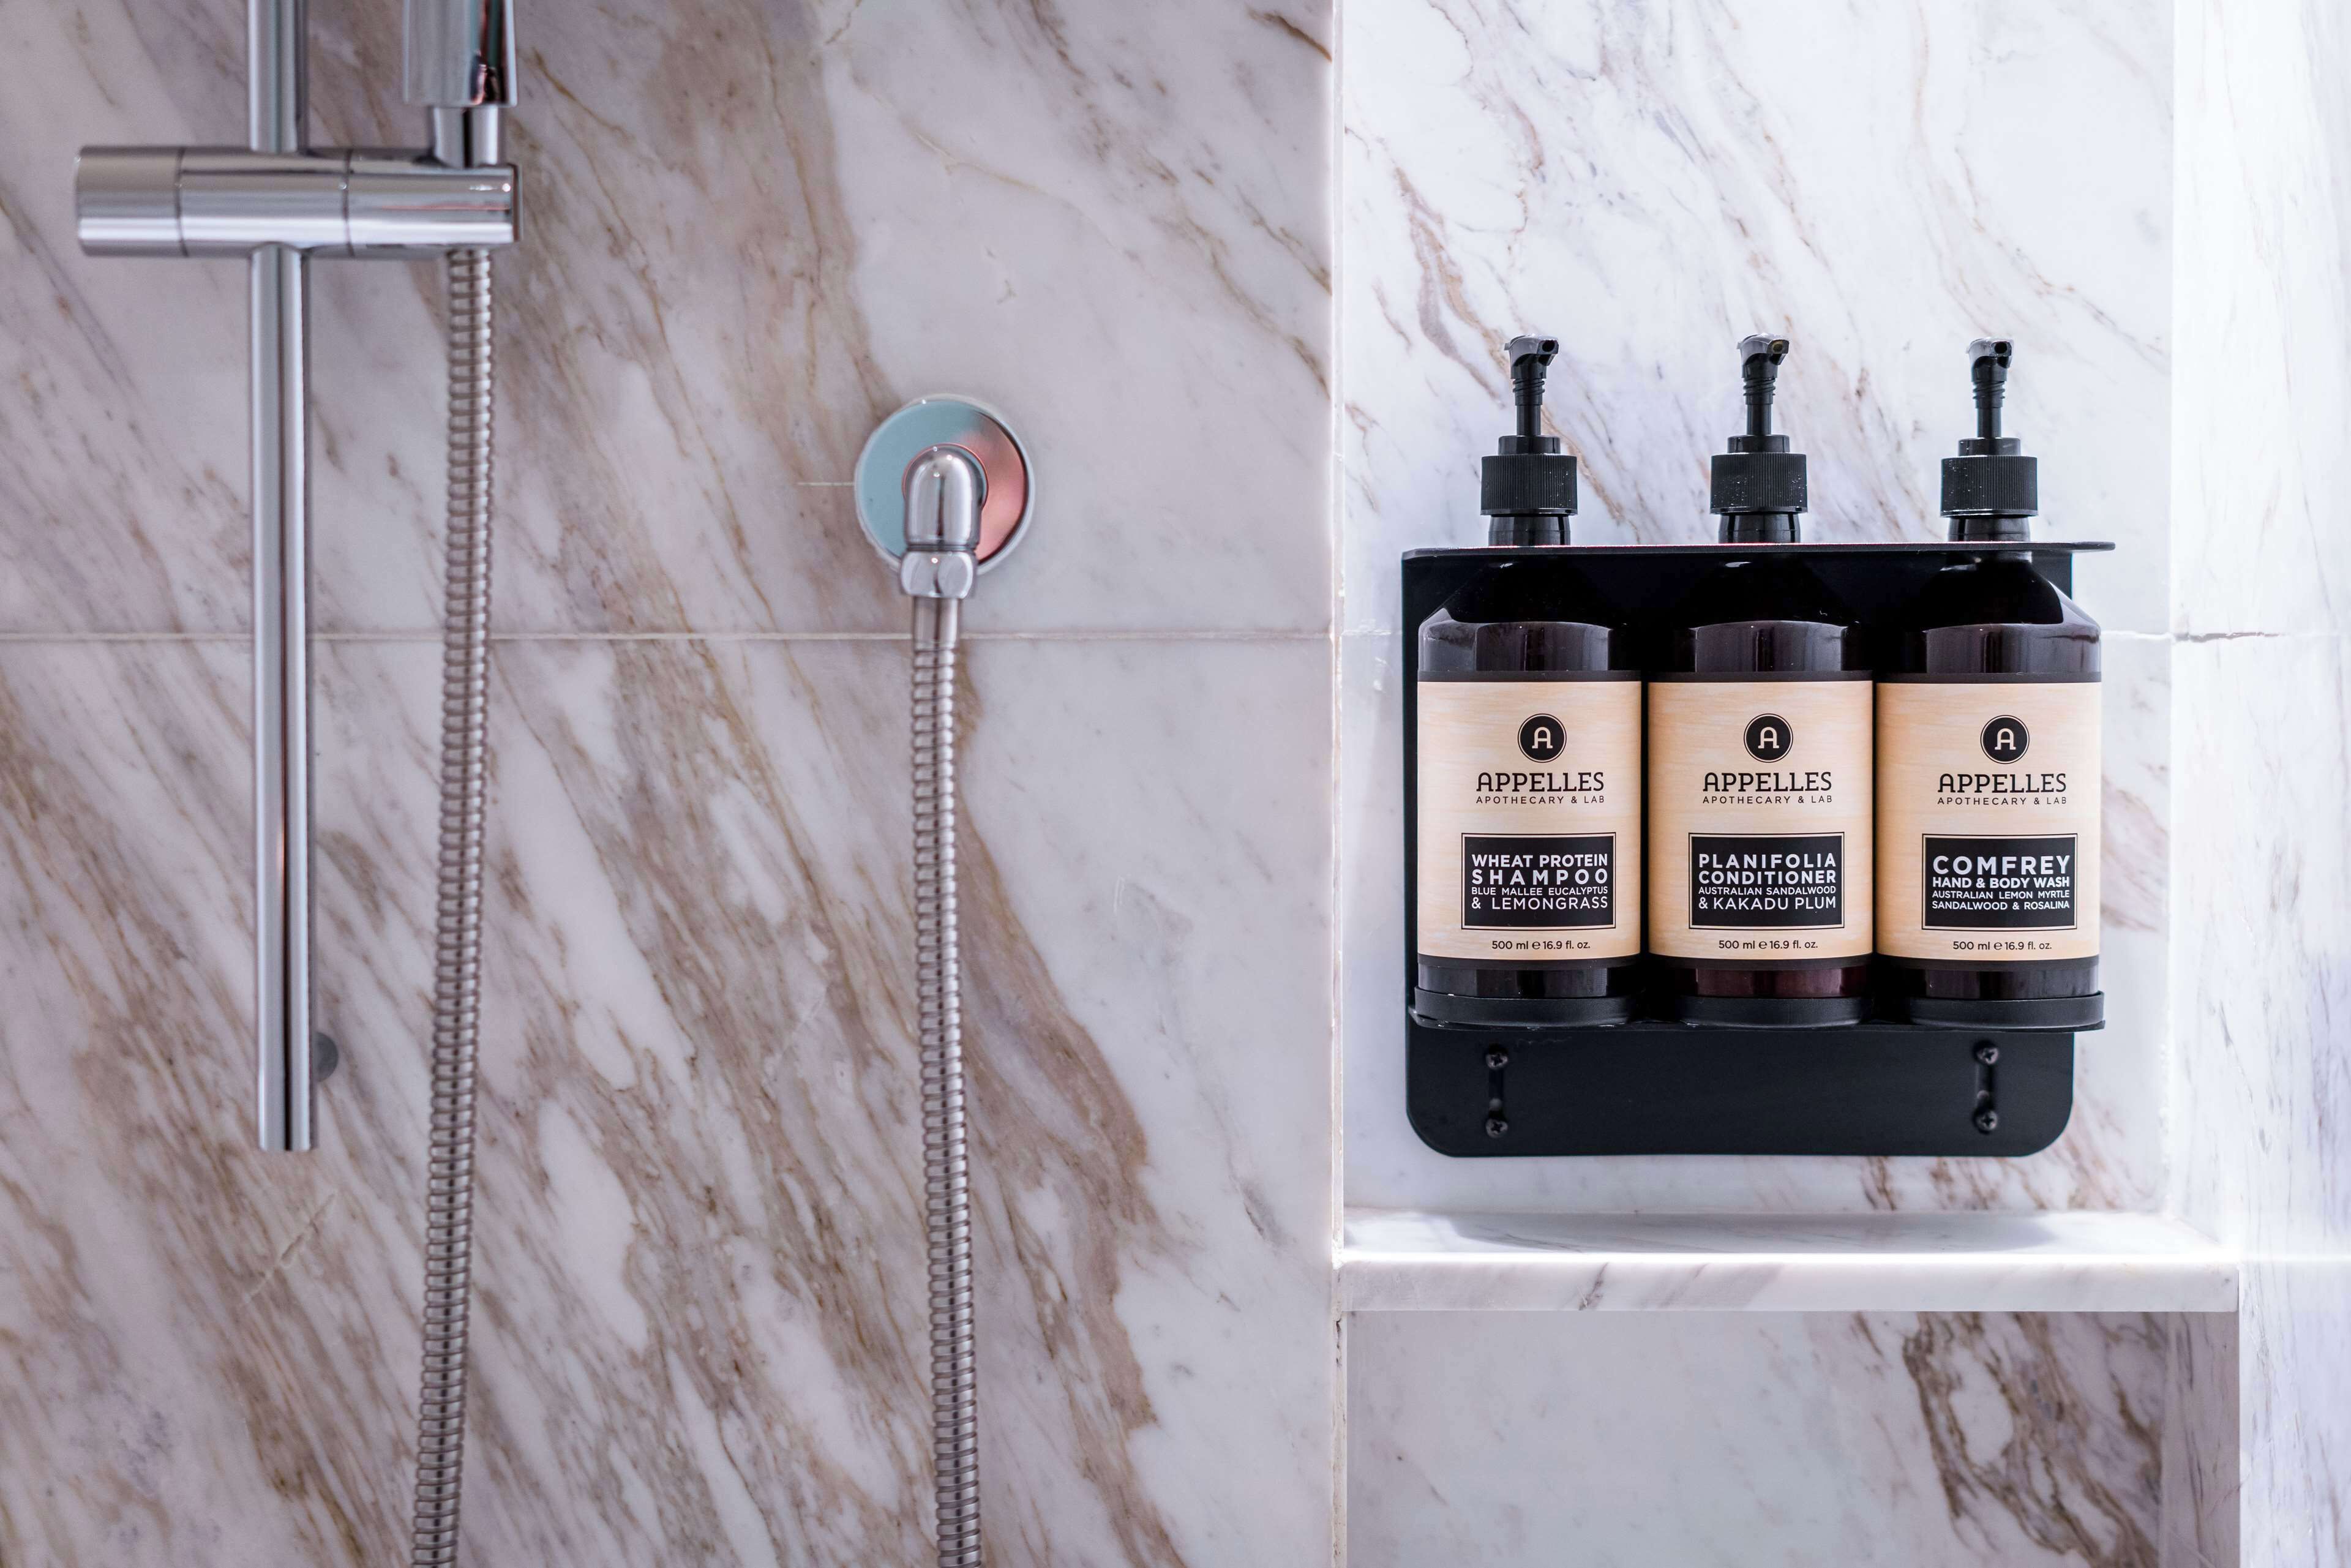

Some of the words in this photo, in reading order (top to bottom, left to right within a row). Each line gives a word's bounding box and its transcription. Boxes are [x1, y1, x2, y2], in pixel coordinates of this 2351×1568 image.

[1532, 726, 1553, 749] A
[1758, 726, 1779, 749] A
[1995, 728, 2016, 750] A
[1476, 772, 1604, 792] APPELLES
[1703, 771, 1832, 792] APPELLES
[1938, 773, 2066, 793] APPELLES
[1472, 854, 1533, 867] WHEAT
[1540, 854, 1608, 867] PROTEIN
[1700, 853, 1836, 868] PLANIFOLIA
[1933, 855, 2070, 875] COMFREY
[1472, 869, 1608, 885] SHAMPOO
[1699, 870, 1836, 885] CONDITIONER
[1932, 877, 1972, 888] HAND
[1976, 877, 1985, 888] &
[1989, 877, 2030, 888] BODY
[2034, 876, 2069, 887] WASH
[1472, 887, 1496, 895] BLUE
[1502, 887, 1542, 895] MALLEE
[1548, 887, 1608, 895] EUCALYPTUS
[1699, 887, 1762, 895] AUSTRALIAN
[1766, 887, 1836, 895] SANDALWOOD
[1932, 890, 1993, 899] AUSTRALIAN
[1999, 890, 2033, 899] LEMON
[2038, 890, 2069, 899] MYRTLE
[1472, 898, 1481, 909] &
[1493, 897, 1608, 910] LEMONGRASS
[1699, 897, 1708, 909] &
[1714, 898, 1788, 910] KAKADU
[1795, 896, 1836, 909] PLUM
[1932, 901, 2008, 910] SANDALWOOD
[2012, 901, 2020, 910] &
[2024, 900, 2070, 910] ROSALINA
[1491, 940, 1513, 949] 500
[1517, 940, 1528, 949] ml
[1565, 940, 1574, 949] fl.
[1719, 940, 1739, 949] 500
[1743, 940, 1755, 949] ml
[1793, 940, 1801, 949] fl.
[1952, 941, 1974, 950] 500
[1978, 941, 1990, 950] ml
[2028, 940, 2036, 950] fl.
